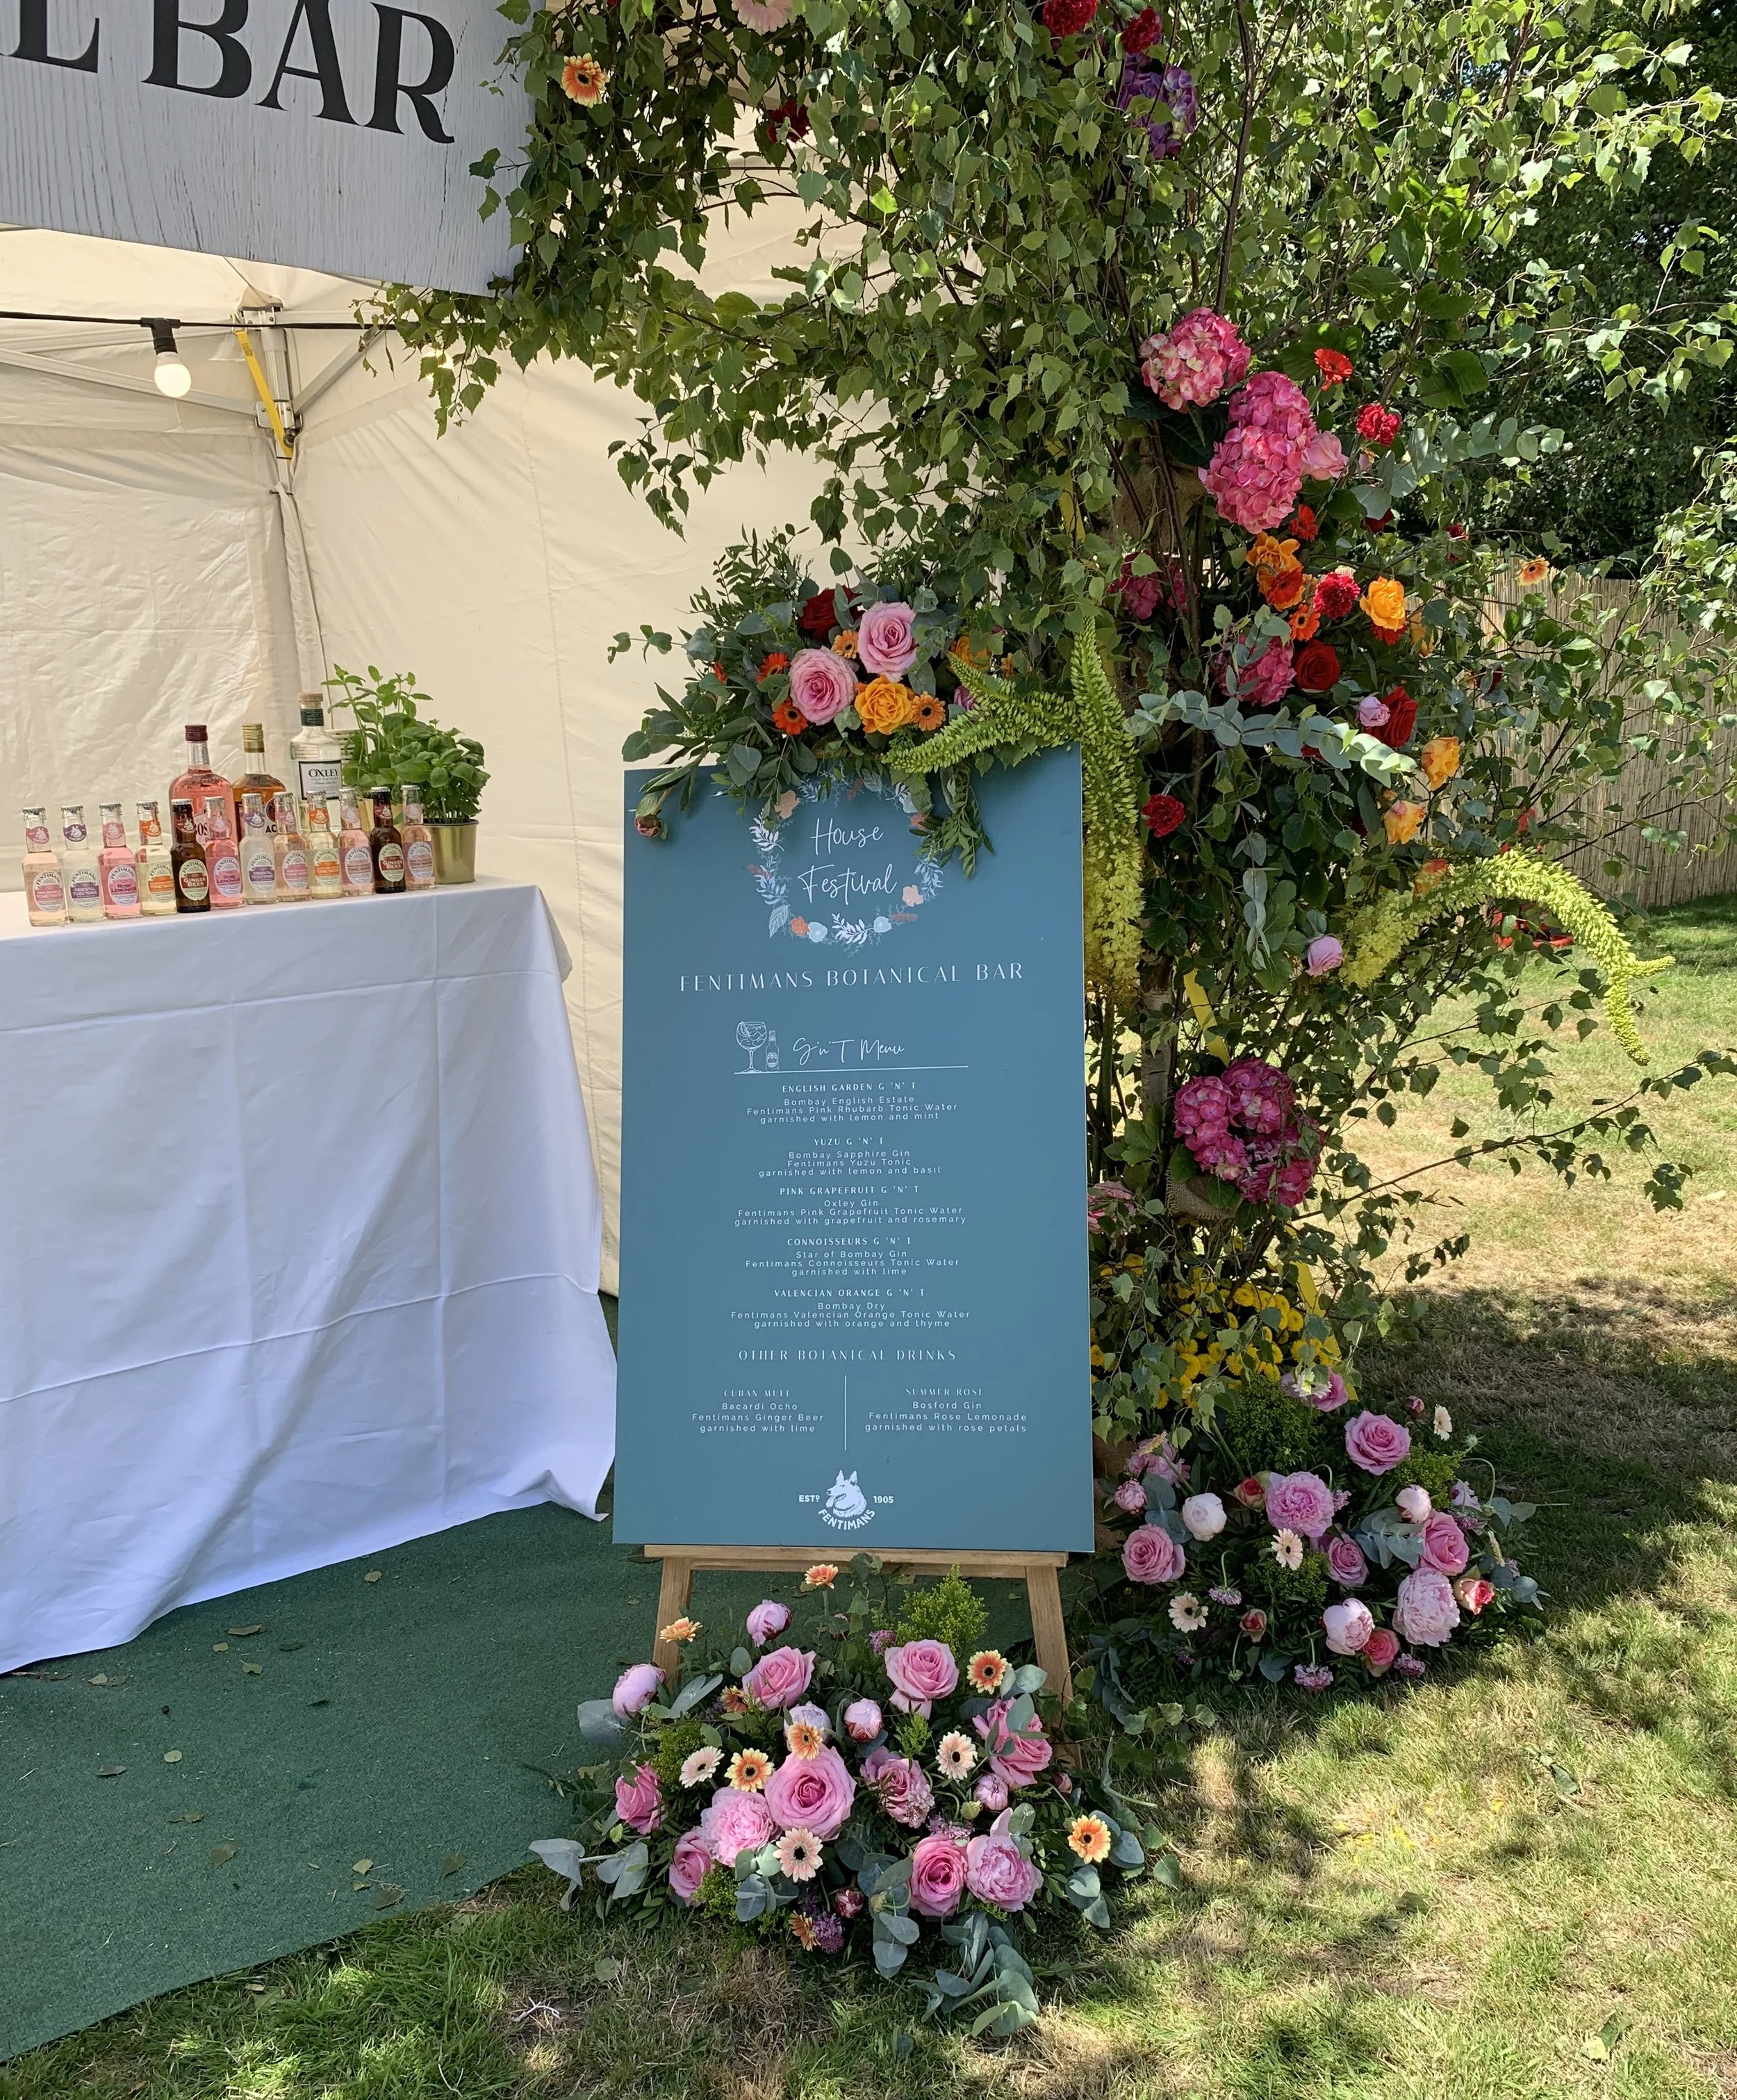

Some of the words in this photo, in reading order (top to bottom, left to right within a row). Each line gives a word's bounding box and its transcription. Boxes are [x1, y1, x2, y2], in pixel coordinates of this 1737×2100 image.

[140, 0, 454, 143] BAR
[308, 769, 338, 778] OXLEY
[810, 818, 884, 855] House
[150, 864, 172, 876] FENTIMA
[797, 864, 898, 905] Festival
[681, 971, 812, 991] FENTIMANS
[828, 965, 961, 986] BOTANICAL
[977, 963, 1022, 980] BAR
[861, 1039, 905, 1060] Menu
[832, 1097, 873, 1106] English
[761, 1115, 814, 1124] garnished
[789, 1151, 831, 1161] Bombay
[837, 1151, 886, 1159] Sapphire
[759, 1169, 813, 1178] garnished
[810, 1186, 873, 1195] GRAPEFRUIT
[824, 1200, 855, 1208] Oxley
[830, 1208, 888, 1217] Grapefruit
[735, 1217, 789, 1227] garnished
[825, 1217, 881, 1226] grapefruit
[914, 1216, 965, 1225] rosemary
[841, 1251, 883, 1259] Bombay
[792, 1268, 847, 1277] garnished
[818, 1302, 861, 1311] Bombay
[867, 1302, 884, 1311] Dry
[855, 1311, 894, 1320] Orange
[755, 1320, 809, 1329] garnished
[916, 1320, 950, 1328] thyme
[739, 1350, 787, 1360] OTHER
[798, 1350, 886, 1361] BOTANICAL
[898, 1350, 955, 1360] DRINKS
[755, 1413, 791, 1422] Ginger
[700, 1425, 755, 1433] garnished
[865, 1423, 922, 1432] garnished
[990, 1425, 1026, 1433] petals
[818, 1509, 875, 1530] FENTIMANS
